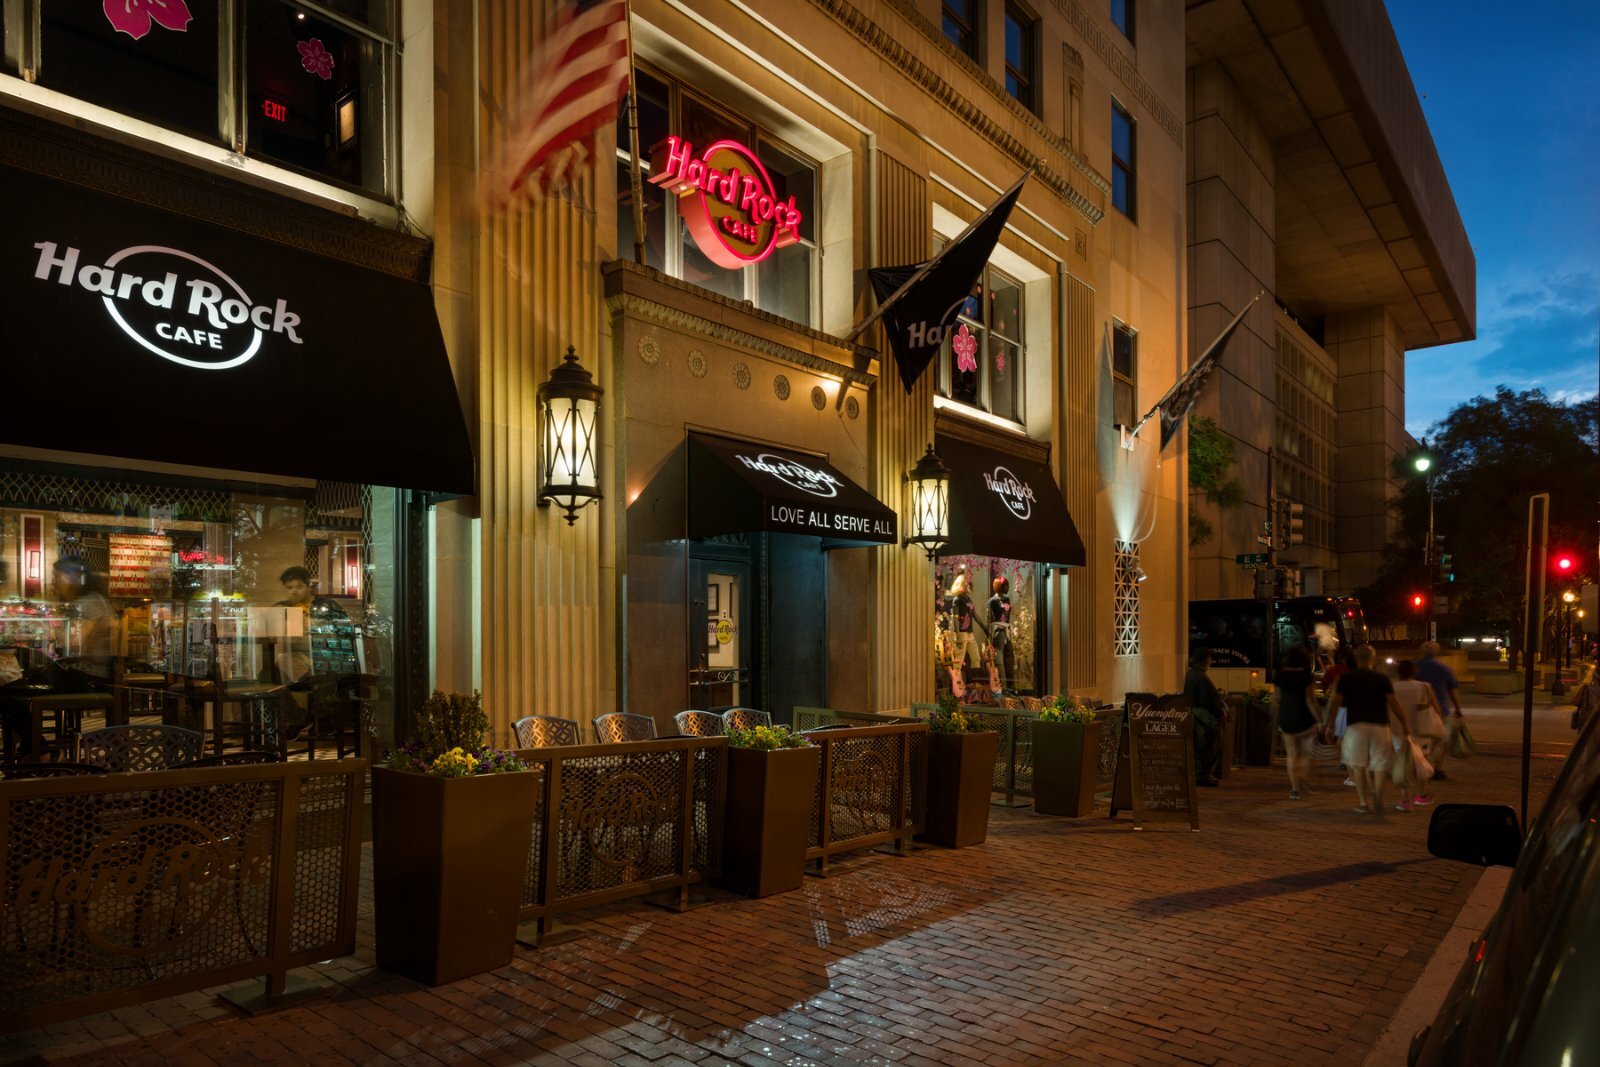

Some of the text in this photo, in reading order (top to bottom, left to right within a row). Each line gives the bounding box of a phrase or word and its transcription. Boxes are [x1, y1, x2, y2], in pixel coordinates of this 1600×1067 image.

[264, 99, 287, 123] EXIT
[667, 136, 802, 242] Hard Rock
[721, 215, 759, 244] CAFE
[34, 241, 304, 344] Hard Rock
[155, 322, 223, 350] CAFE
[735, 454, 794, 477] Hard
[983, 472, 1037, 503] Hard Rock
[771, 505, 893, 535] LOVE ALL SERVE ALL
[1130, 702, 1191, 722] Yuengling
[1145, 723, 1177, 733] LAGER
